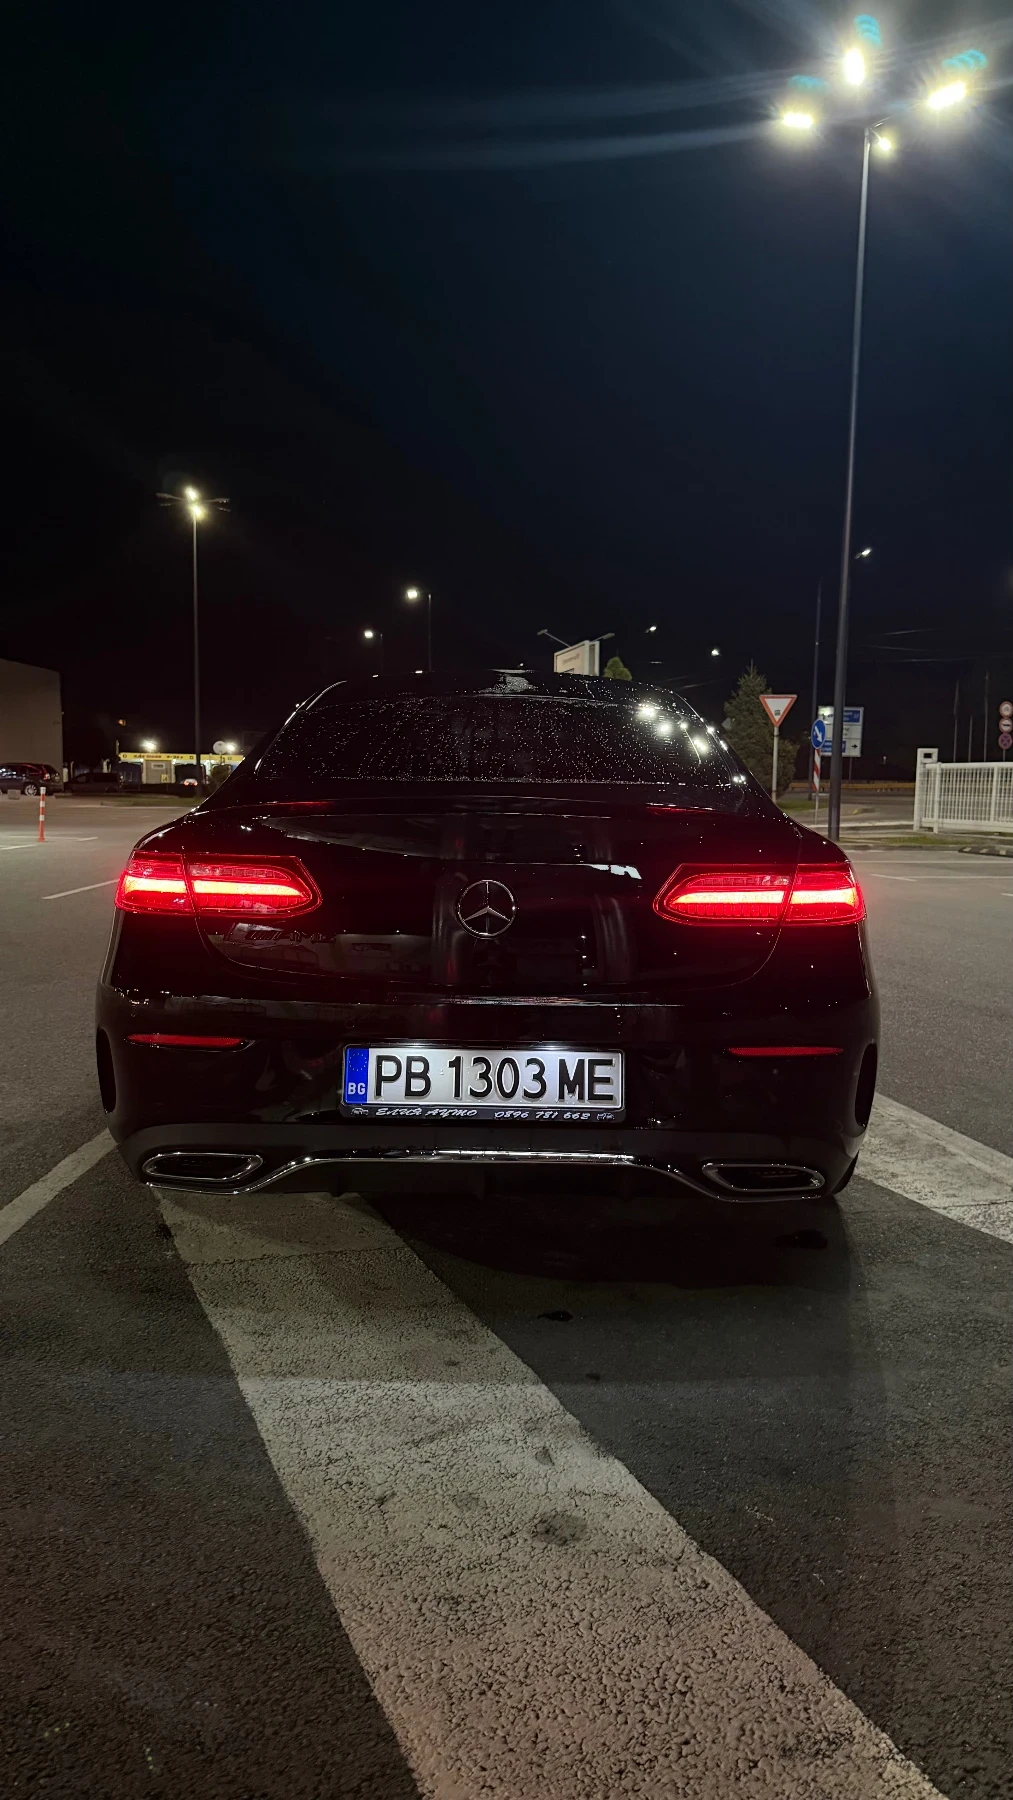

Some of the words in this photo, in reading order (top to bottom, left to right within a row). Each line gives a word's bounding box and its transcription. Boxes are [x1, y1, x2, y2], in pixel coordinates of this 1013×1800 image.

[348, 1082, 366, 1095] BG
[375, 1055, 432, 1097] PB
[448, 1056, 548, 1099] 1303
[558, 1058, 614, 1100] ME
